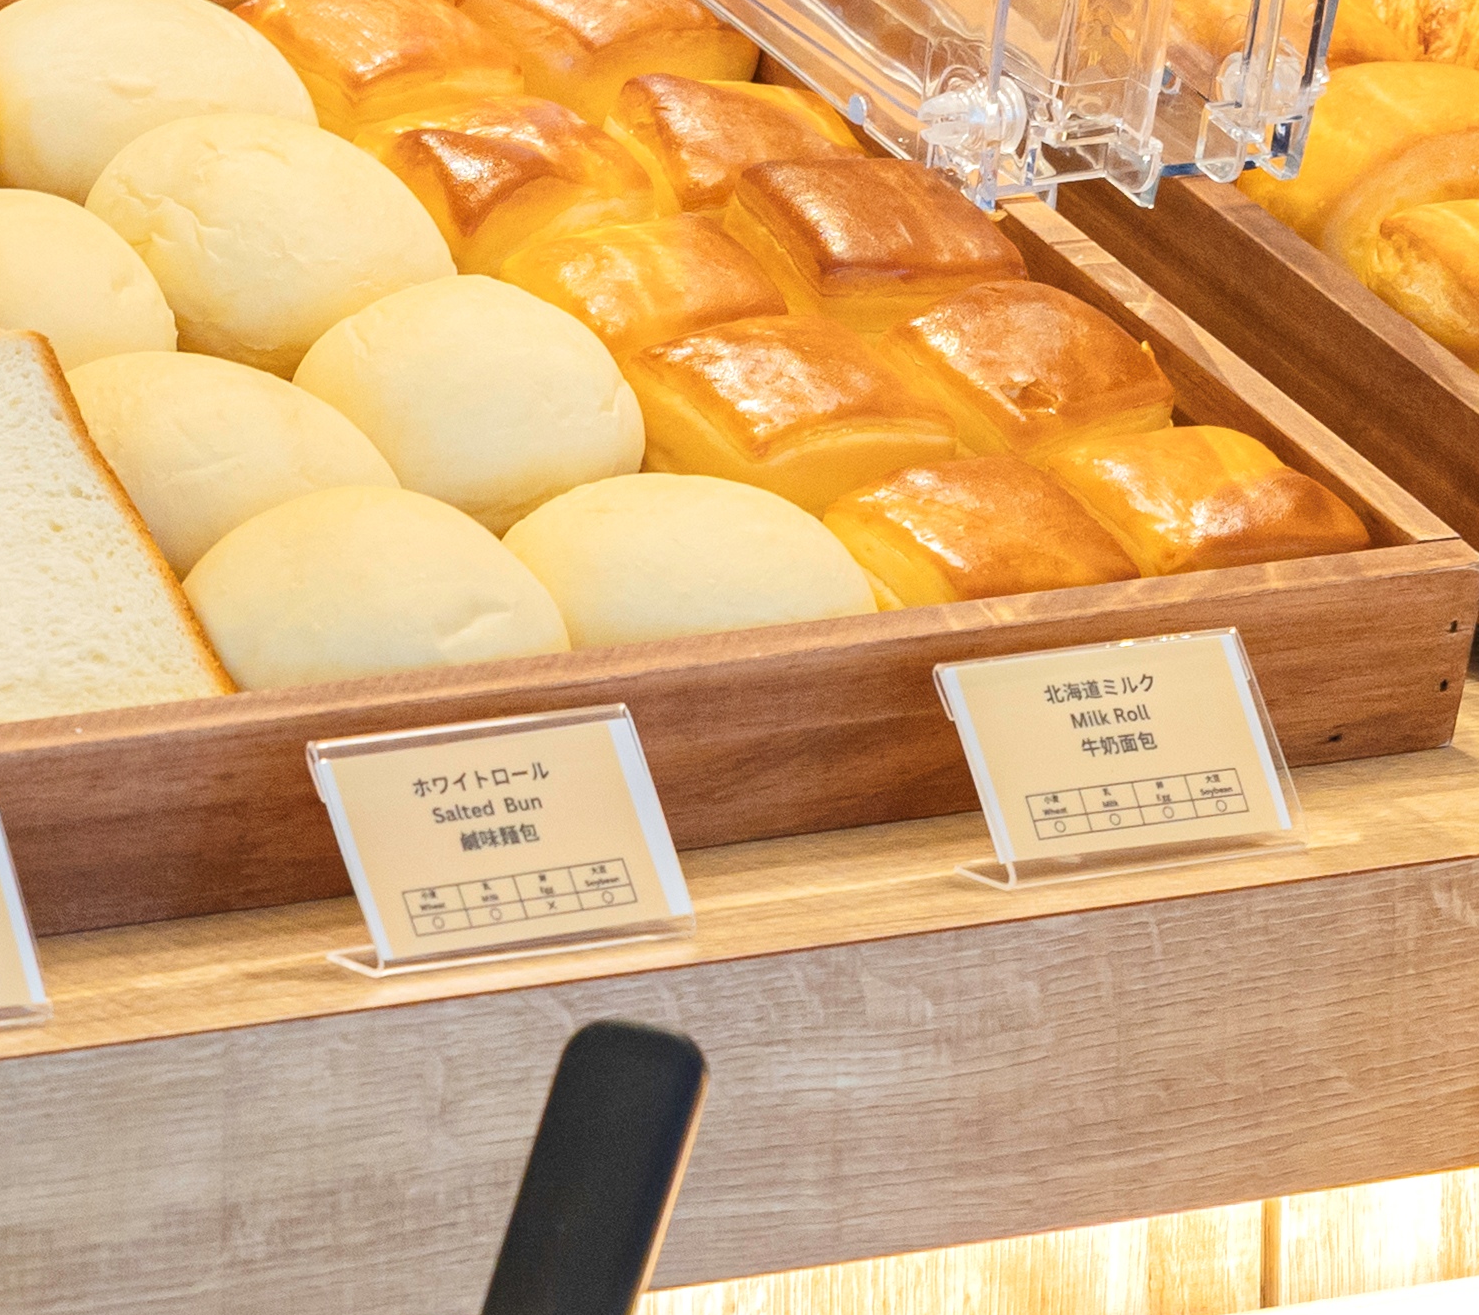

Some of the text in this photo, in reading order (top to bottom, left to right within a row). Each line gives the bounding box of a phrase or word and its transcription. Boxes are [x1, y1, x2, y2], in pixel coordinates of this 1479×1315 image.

[1044, 673, 1155, 704] 北海道ミルク
[1070, 704, 1151, 729] Milk Roll
[1081, 731, 1158, 757] 牛奶面包
[413, 762, 550, 798] ホワイトロール
[432, 795, 543, 824] Salted Bun
